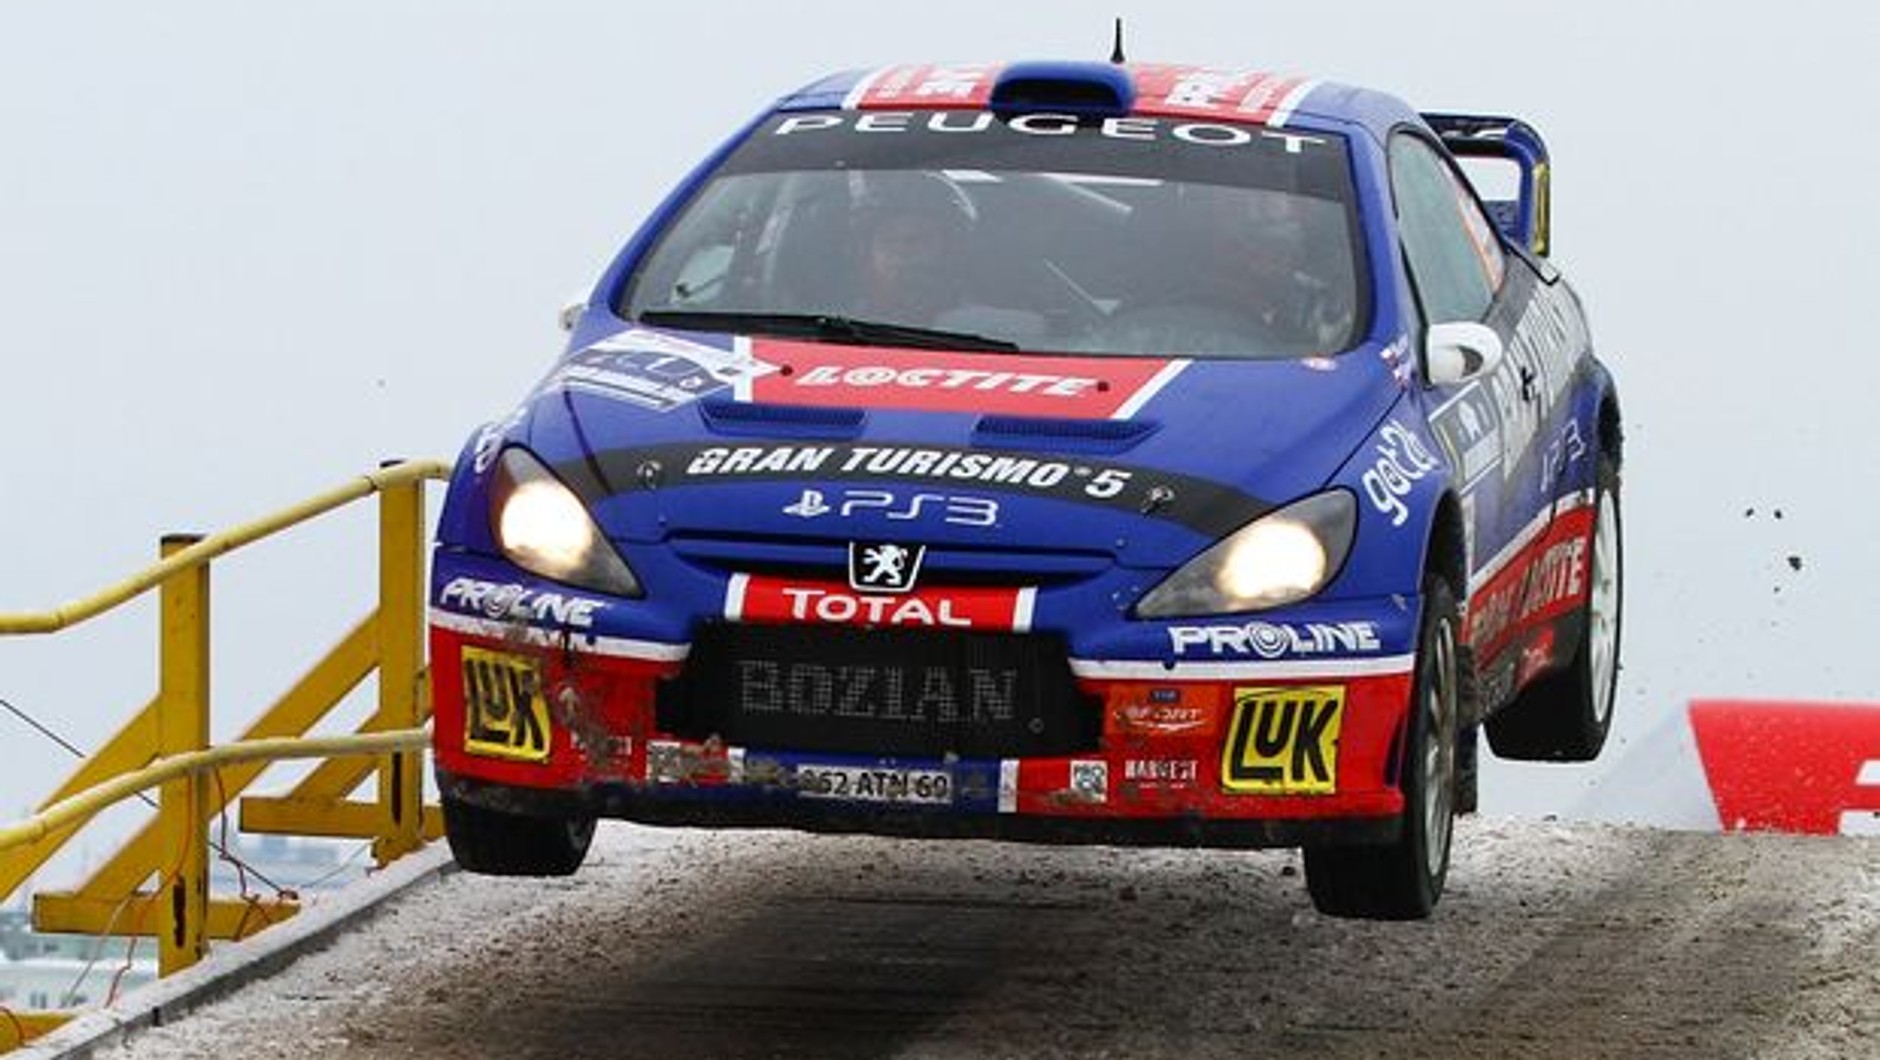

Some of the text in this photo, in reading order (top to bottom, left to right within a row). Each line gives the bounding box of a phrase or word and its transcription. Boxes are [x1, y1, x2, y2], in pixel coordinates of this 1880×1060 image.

[775, 112, 1326, 155] PEUGEOT
[796, 364, 1097, 398] LOCTITE
[687, 446, 822, 475] GRAN
[1085, 466, 1132, 499] 5
[841, 490, 999, 526] PS3
[440, 577, 604, 626] PROLINE
[782, 587, 972, 627] TOTAL
[1168, 621, 1382, 658] PROLINE
[736, 660, 1018, 722] BOZIAN
[855, 771, 908, 799] ATN
